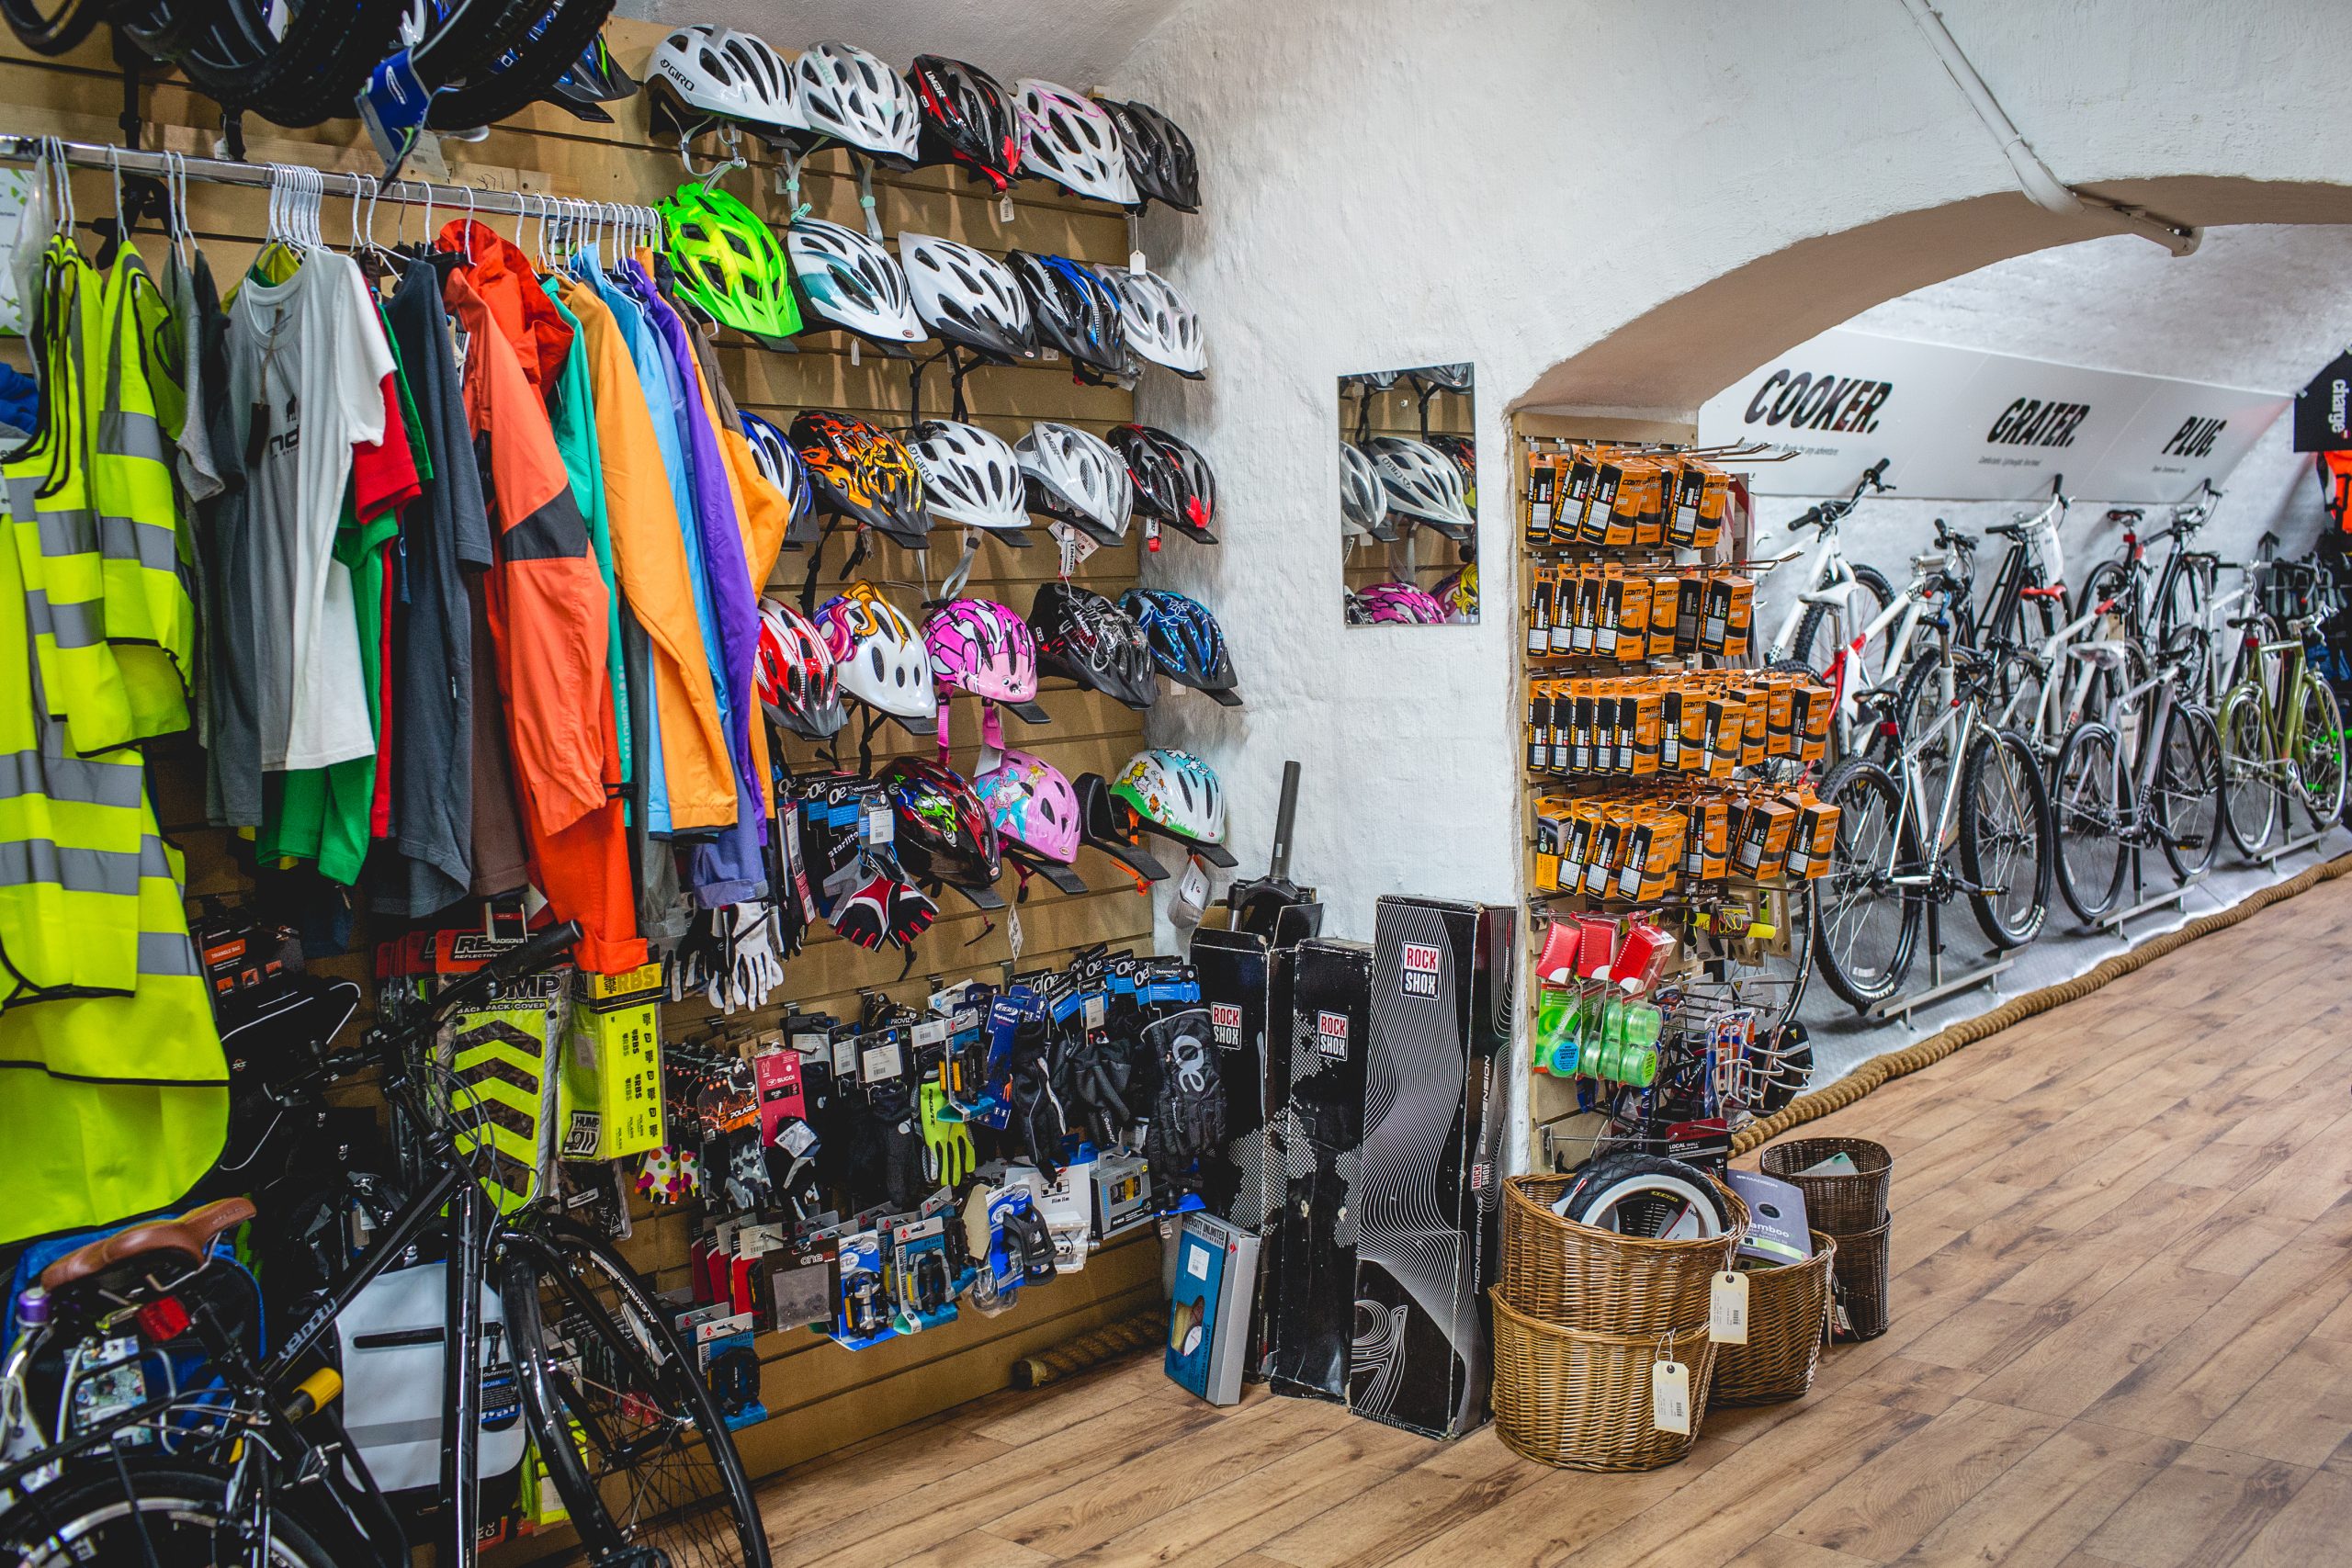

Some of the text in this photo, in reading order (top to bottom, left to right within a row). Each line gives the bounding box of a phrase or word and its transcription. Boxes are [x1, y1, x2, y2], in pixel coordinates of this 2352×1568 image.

[667, 65, 695, 91] GIRO
[1745, 368, 1893, 434] COOKER.
[2328, 379, 2348, 434] charge
[1987, 397, 2090, 447] GRATER.
[913, 455, 935, 484] GIRO
[1406, 947, 1437, 970] ROCK
[1405, 972, 1436, 995] SHOX
[891, 1017, 911, 1025] PROVIZ
[1213, 1007, 1239, 1026] ROCK
[1320, 1016, 1346, 1036] ROCK
[1213, 1025, 1239, 1045] SHOX
[1319, 1036, 1345, 1056] SHOX
[729, 1102, 757, 1120] POLARIS
[1480, 1055, 1490, 1156] SUSPENSION
[575, 1115, 600, 1128] HUMP
[1472, 1164, 1481, 1188] ROCK
[1204, 1222, 1226, 1240] UNLIMITED
[1750, 1223, 1790, 1238] amboo
[1474, 1197, 1485, 1294] PIONEERING
